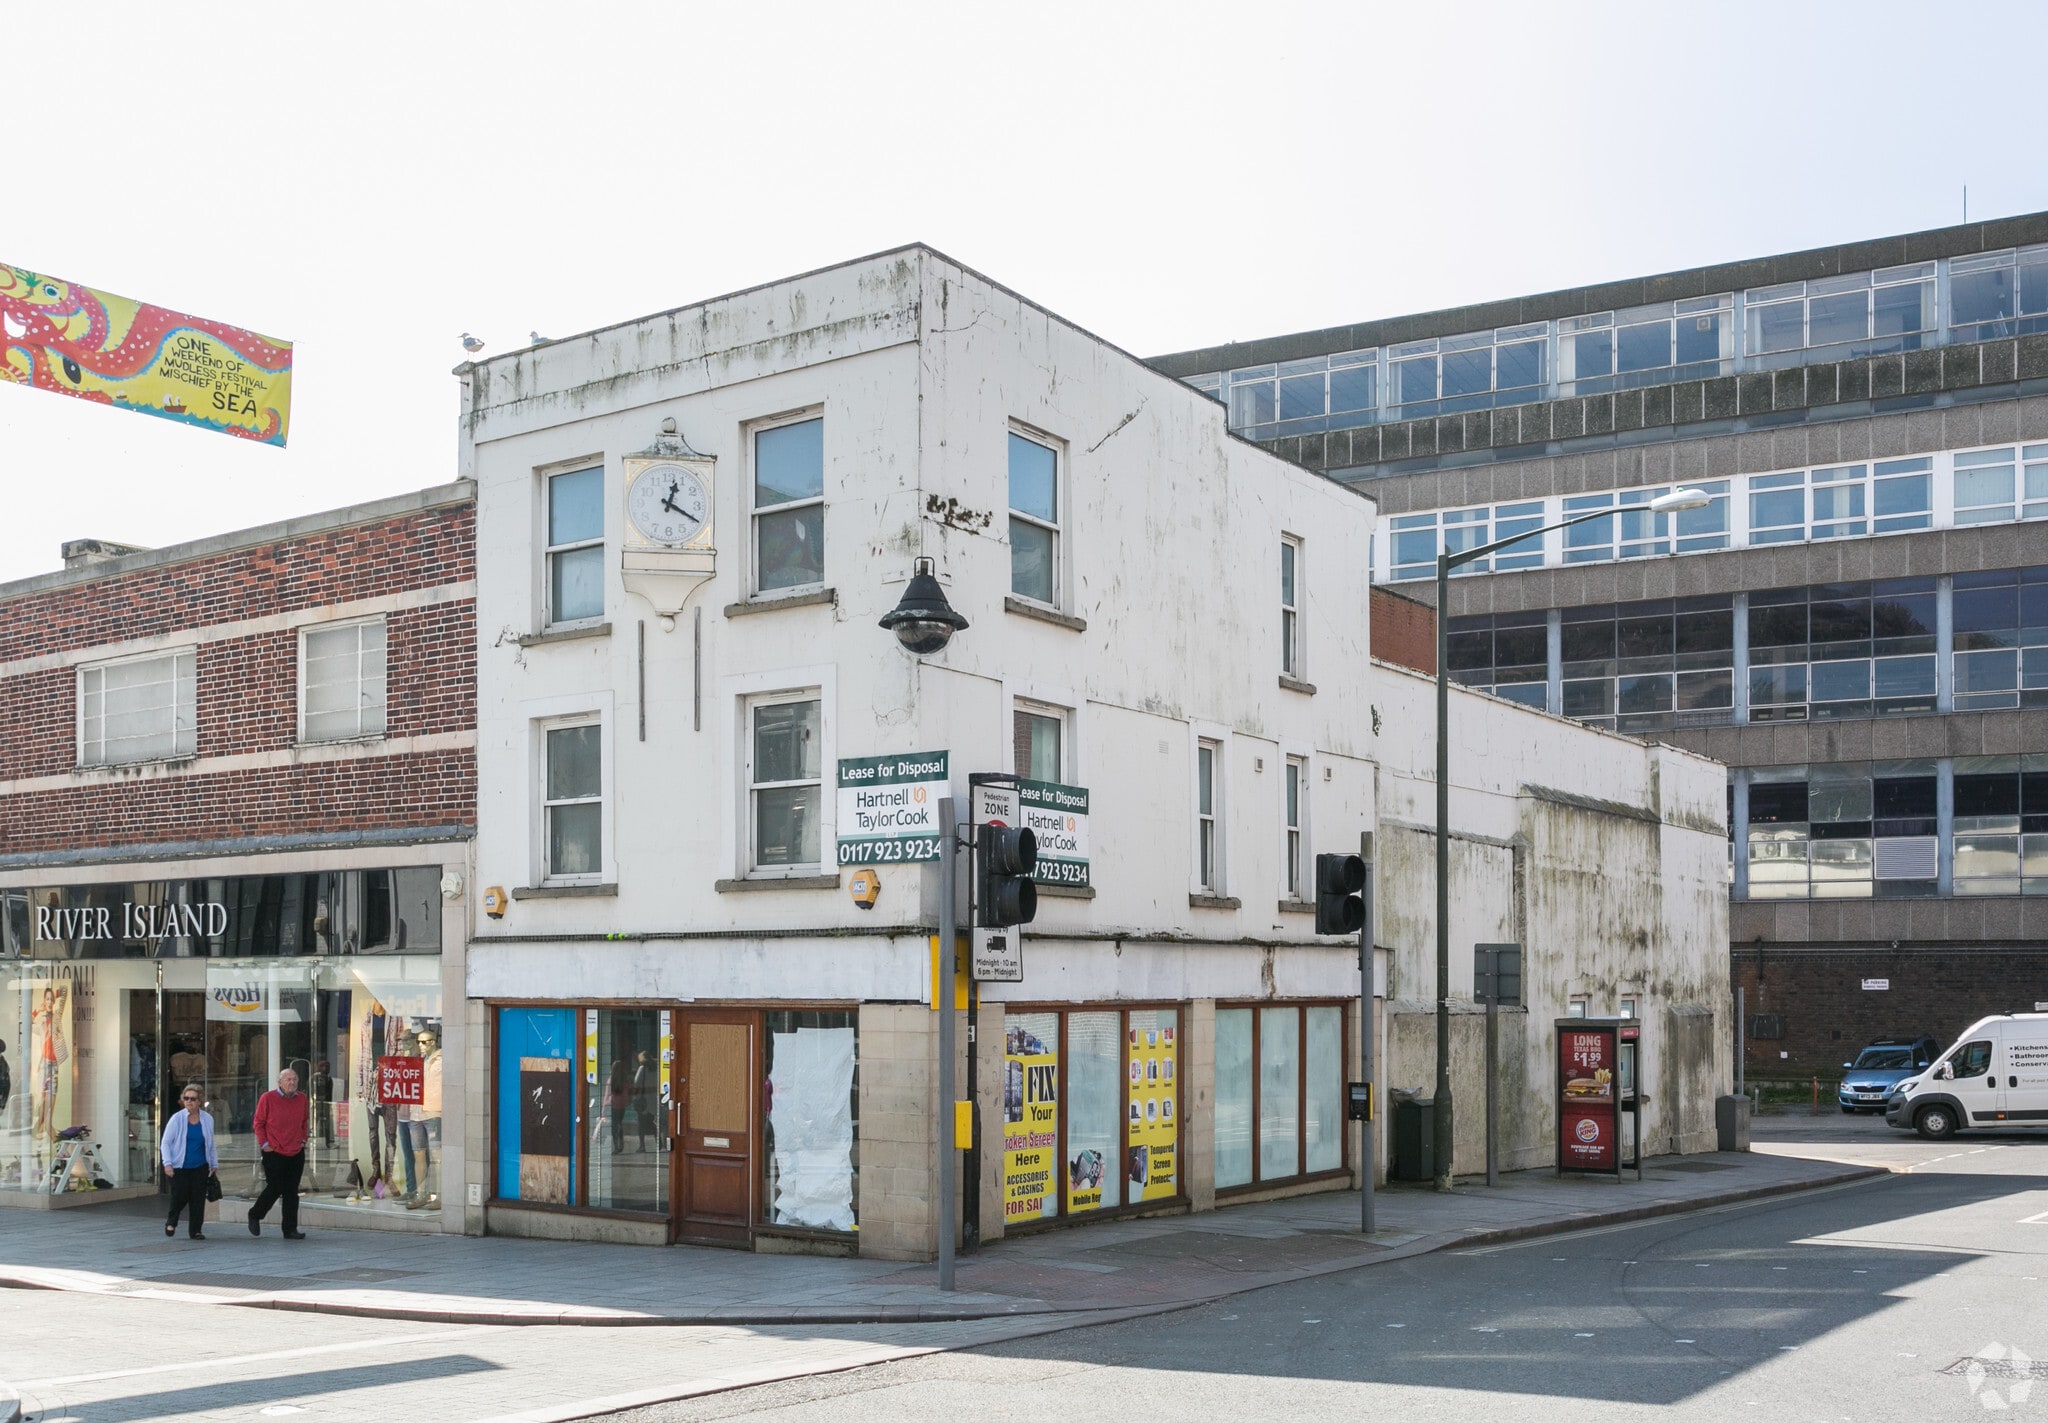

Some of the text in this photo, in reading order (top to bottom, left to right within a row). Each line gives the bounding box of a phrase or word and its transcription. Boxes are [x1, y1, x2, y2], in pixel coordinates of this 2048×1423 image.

[177, 337, 211, 356] ONE
[172, 347, 245, 372] WEEKEND OF
[164, 357, 268, 390] MUDLESS FESTIVAL
[159, 367, 254, 398] MISCHIEF BY THE
[212, 391, 257, 418] SEA
[689, 486, 697, 497] 2
[694, 500, 701, 511] 3
[665, 526, 673, 536] 6
[679, 523, 686, 533] 5
[842, 758, 944, 780] Lease for Disposal
[857, 788, 909, 808] Hartnell
[984, 792, 1010, 802] Pedestrian
[1042, 789, 1054, 800] for
[1056, 791, 1087, 808] Disposal
[984, 803, 1009, 816] ZONE
[856, 808, 929, 831] Taylor Cook
[1027, 811, 1064, 832] Hartnell
[1036, 832, 1078, 852] ylor Cook
[840, 842, 873, 862] 0117
[874, 841, 902, 860] 923
[1041, 861, 1061, 881] 923
[1062, 863, 1088, 883] 9234
[36, 902, 228, 941] RIVER ISLAND
[976, 958, 1000, 967] Midnight
[1003, 959, 1010, 967] 10
[978, 967, 982, 975] 6
[994, 968, 1018, 977] Midnight
[1573, 1035, 1602, 1046] LONG
[1573, 1052, 1602, 1067] £1.99
[383, 1068, 420, 1080] 50% OFF
[382, 1081, 420, 1100] SALE
[1027, 1065, 1056, 1103] FIX
[1030, 1106, 1053, 1122] Your
[1580, 1128, 1596, 1136] KING
[1150, 1143, 1175, 1156] Tempered
[1015, 1153, 1040, 1166] Here
[1153, 1159, 1171, 1170] Screen
[1006, 1170, 1049, 1185] ACCESSORIES
[1011, 1182, 1045, 1197] & CASINGS
[1073, 1194, 1091, 1206] Mobile
[1006, 1200, 1024, 1216] FOR
